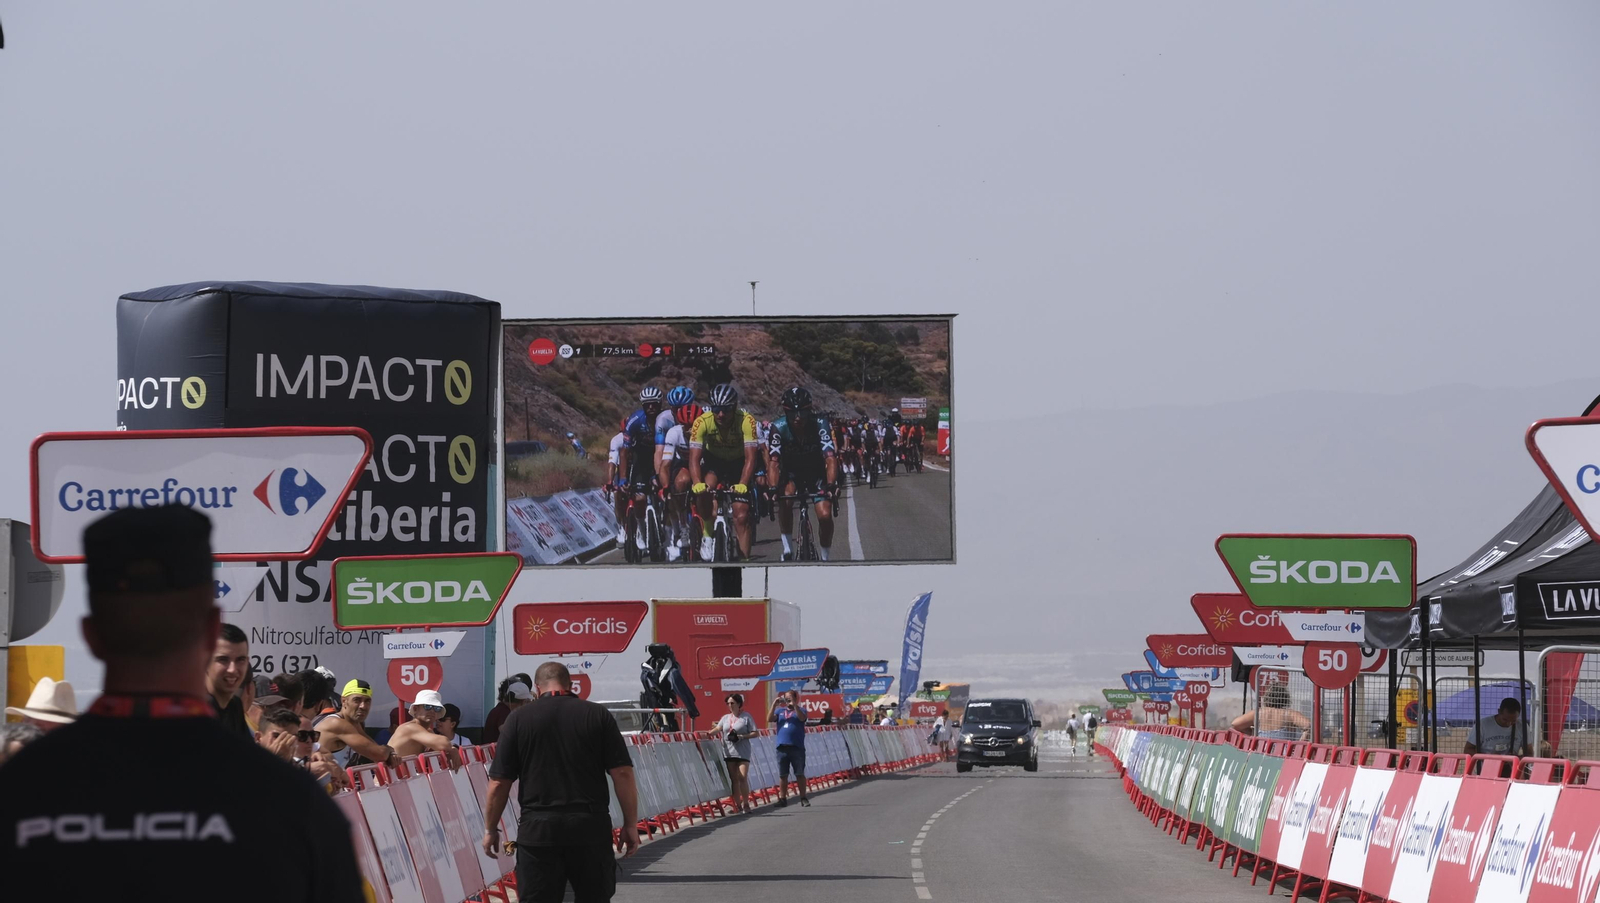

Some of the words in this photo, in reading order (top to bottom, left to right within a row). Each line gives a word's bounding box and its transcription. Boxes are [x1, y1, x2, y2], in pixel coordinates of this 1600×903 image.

[575, 347, 582, 355] 1
[602, 347, 620, 355] 77,5
[621, 347, 634, 355] km
[654, 347, 662, 355] 2
[696, 346, 713, 354] 1:54
[58, 478, 238, 512] Carrefour
[1250, 555, 1401, 584] ŠKODA
[255, 560, 332, 604] NS
[347, 577, 492, 605] ŠKODA
[1552, 589, 1578, 612] LA
[553, 617, 628, 635] Cofidis
[696, 616, 705, 624] LA
[704, 616, 725, 624] VUELTA
[1301, 623, 1342, 632] Carrefour
[251, 625, 353, 646] Nitrosulfato
[387, 641, 426, 650] Carrefour
[905, 614, 925, 672] valsir
[1177, 644, 1227, 656] Cofidis
[722, 653, 771, 667] Cofidis
[777, 655, 817, 666] LOTERÍAS
[1247, 652, 1276, 660] Carrefour
[1317, 649, 1348, 671] 50
[281, 654, 319, 675] (37)
[401, 665, 429, 686] 50
[1188, 684, 1208, 694] 100
[1177, 692, 1191, 702] 12
[801, 699, 829, 713] rtve
[917, 704, 937, 715] rtve
[16, 812, 234, 847] POLICIA
[1536, 831, 1584, 889] Carrefour
